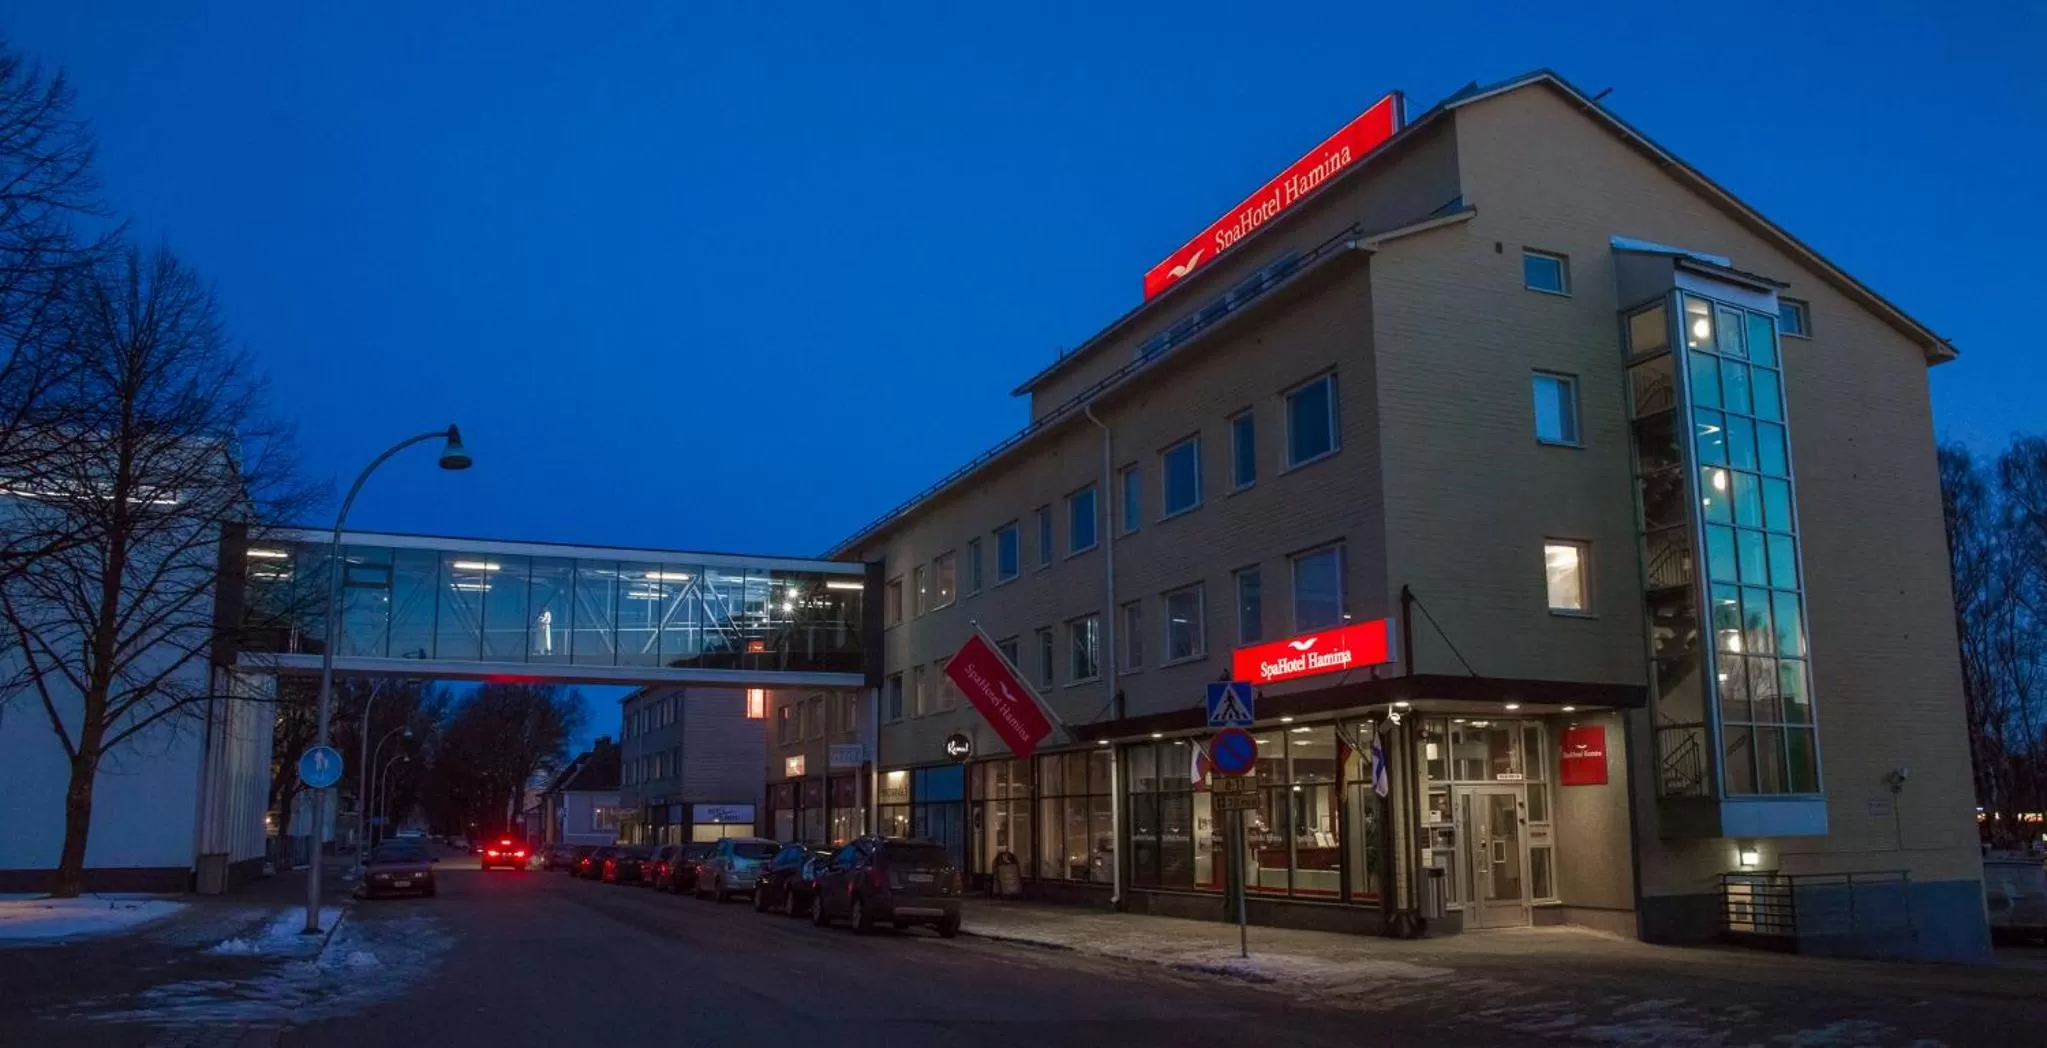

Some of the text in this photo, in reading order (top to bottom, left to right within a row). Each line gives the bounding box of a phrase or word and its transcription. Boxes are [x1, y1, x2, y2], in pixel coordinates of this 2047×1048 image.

[1214, 144, 1352, 253] SpaHotel Hamina
[963, 663, 1031, 742] SpaHotel Hamina
[1260, 648, 1352, 680] SpaHotel Hamina
